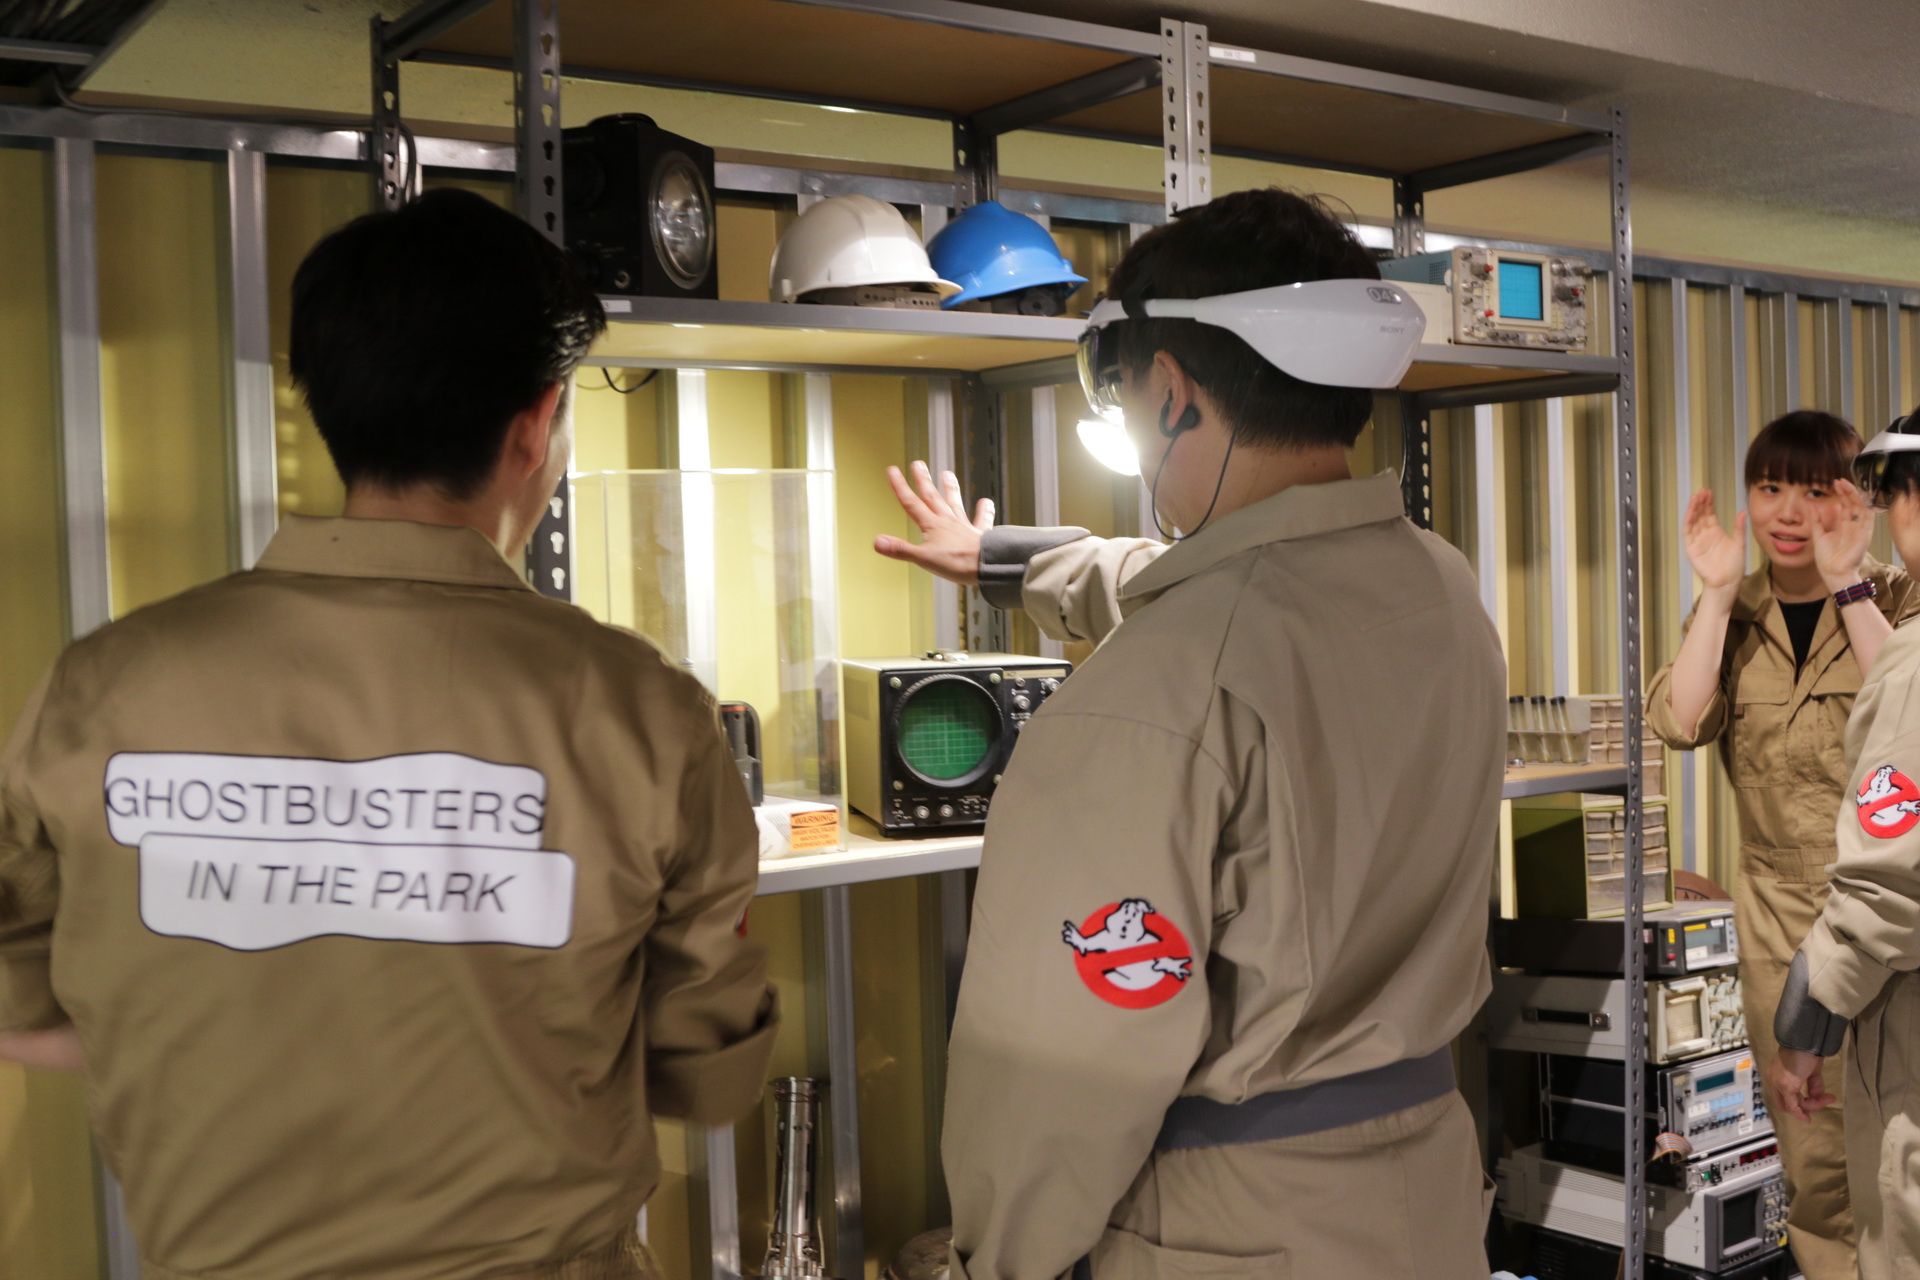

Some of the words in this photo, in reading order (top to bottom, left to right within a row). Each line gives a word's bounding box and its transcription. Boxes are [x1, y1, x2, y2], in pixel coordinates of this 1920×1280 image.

[1380, 325, 1405, 335] SONY
[105, 777, 546, 835] GHOSTBUSTERS
[794, 813, 834, 825] WARNING
[187, 860, 238, 902] IN
[257, 864, 357, 906] THE
[370, 870, 518, 913] PARK
